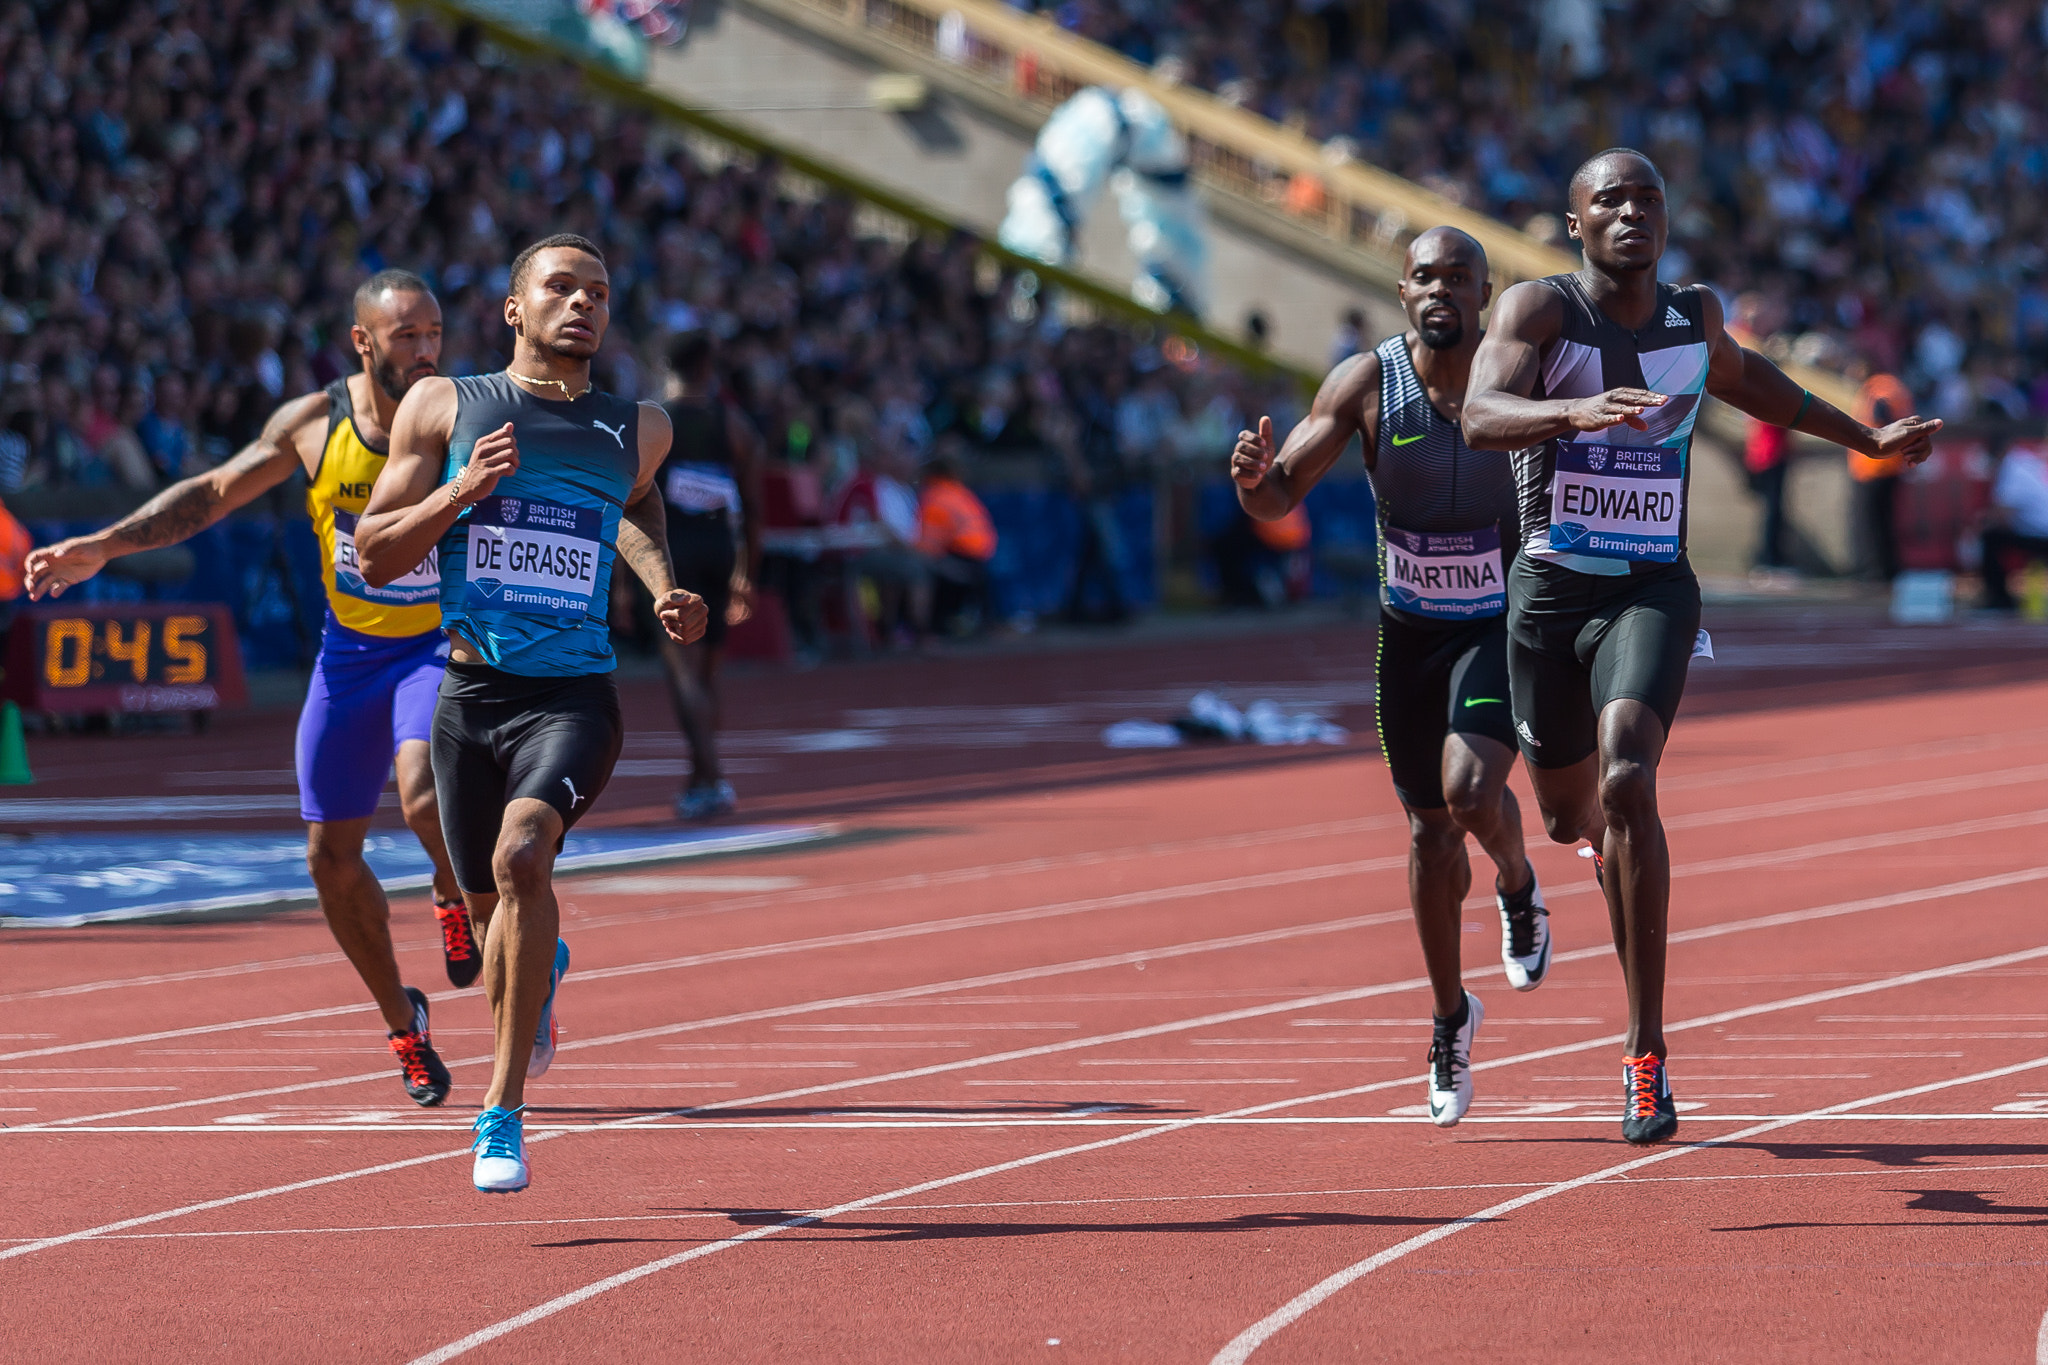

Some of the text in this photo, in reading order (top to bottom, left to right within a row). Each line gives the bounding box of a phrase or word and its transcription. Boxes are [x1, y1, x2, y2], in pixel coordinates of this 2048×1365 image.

[1664, 317, 1691, 328] adidas
[1616, 450, 1661, 463] BRITISH
[1614, 462, 1661, 472] ATHLETICS
[1562, 483, 1674, 522] EDWARD
[528, 503, 577, 520] BRITISH
[527, 515, 576, 529] ATHLETICS
[1427, 535, 1473, 545] BRITISH
[1427, 544, 1475, 552] ATHLETICS
[1589, 535, 1674, 555] Birmingham
[475, 538, 504, 570] DE
[509, 540, 592, 582] GRASSE
[1394, 554, 1498, 589] MARTINA
[503, 589, 589, 612] Birmingham
[1420, 599, 1502, 615] Birmingham
[45, 614, 208, 688] 0:45
